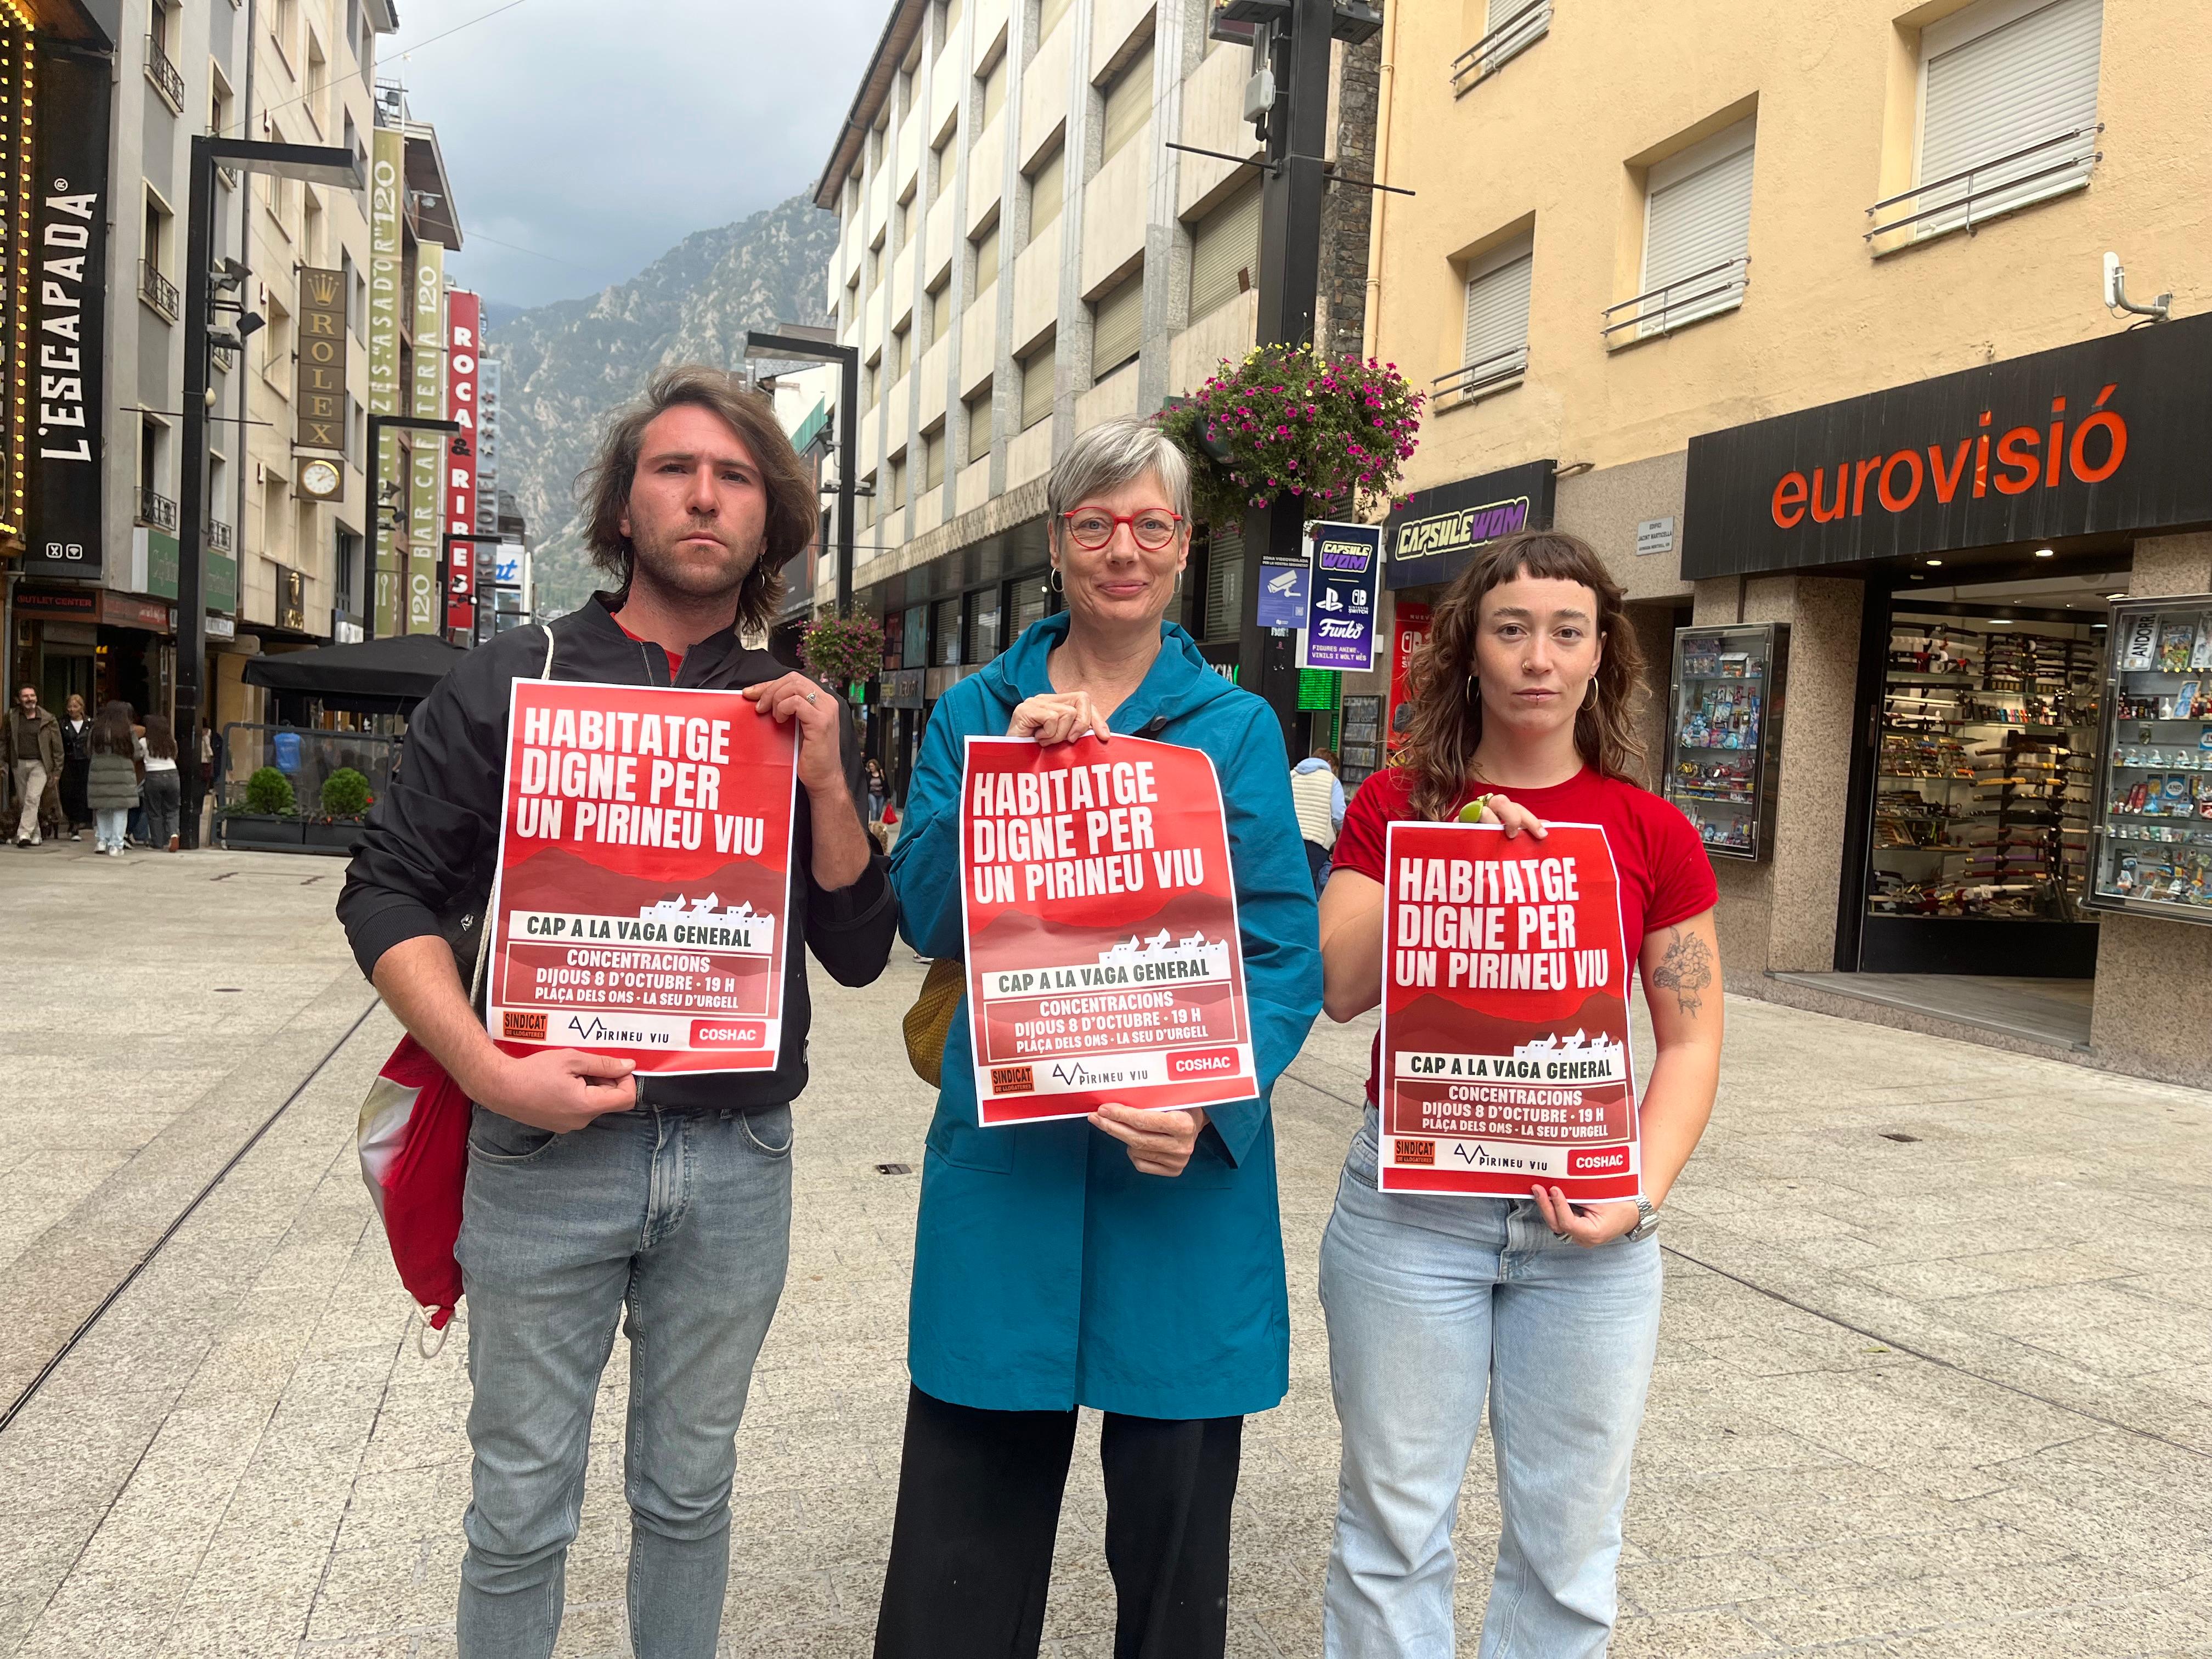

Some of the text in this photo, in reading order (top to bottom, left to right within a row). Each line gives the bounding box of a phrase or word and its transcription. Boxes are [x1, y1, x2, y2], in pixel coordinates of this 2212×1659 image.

[373, 160, 396, 224] 120
[418, 265, 437, 315] 120
[309, 312, 335, 445] ROLEX
[453, 326, 475, 429] ROCA
[415, 331, 437, 487] CAFTERIA
[1771, 382, 2129, 529] eurovisió
[1322, 553, 1368, 570] WOM
[1323, 544, 1370, 556] CAPSULE
[411, 575, 430, 624] 120
[1318, 618, 1364, 640] Funko
[2132, 613, 2157, 657] ANDORR
[1312, 644, 1338, 652] FIGURES
[524, 707, 731, 765] HABITATGE
[521, 748, 720, 810] DIGNE PER
[973, 761, 1158, 816] HABITATGE
[516, 797, 764, 856] UN PIRINEU VIU
[974, 806, 1155, 863] DIGNE PER
[974, 848, 1204, 904] UN PIRINEU VIU
[1398, 857, 1579, 904] HABITATGE
[527, 916, 752, 947] CAP A LA VAGA GENERAL
[1397, 904, 1576, 950] DIGNE PER
[567, 949, 710, 973] CONCENTRACIONS
[1395, 948, 1609, 991] UN PIRINEU VIU
[536, 968, 590, 988] DIJOUS
[595, 970, 605, 985] 8
[705, 977, 720, 992] 19
[724, 978, 735, 992] H
[999, 958, 1210, 992] CAP A LA VAGA GENERAL
[535, 988, 573, 1005] PLAÇA
[577, 990, 605, 1004] DELS
[608, 990, 634, 1004] OMS
[643, 994, 657, 1005] LA
[659, 994, 681, 1007] SEU
[1040, 991, 1173, 1017] CONCENTRACIONS
[505, 1013, 546, 1029] SINDICAT
[1014, 1019, 1065, 1039] DIJOUS
[1069, 1019, 1078, 1032] 8
[1171, 1009, 1188, 1024] 19
[1191, 1008, 1201, 1022] H
[596, 1029, 669, 1043] PIRINEU VIU
[699, 1028, 756, 1042] COSHAC
[1017, 1038, 1053, 1054] PLAÇA
[1056, 1036, 1082, 1049] DELS
[1085, 1034, 1108, 1048] OMS
[1116, 1032, 1130, 1045] LA
[1132, 1031, 1153, 1043] SEU
[992, 1068, 1030, 1084] SINDICAT
[1176, 1056, 1231, 1072] COSHAC
[1411, 1056, 1612, 1079] CAP A LA VAGA GENERAL
[1079, 1070, 1148, 1085] PIRINEU VIU
[1448, 1085, 1582, 1106] CONCENTRACIONS
[1422, 1101, 1471, 1120] DIJOUS
[1475, 1104, 1483, 1117] 8
[1578, 1109, 1592, 1122] 19
[1595, 1108, 1604, 1121] H
[1422, 1118, 1457, 1132] PLAÇA
[1459, 1120, 1486, 1132] DELS
[1489, 1122, 1513, 1135] OMS
[1521, 1124, 1534, 1136] LA
[1537, 1125, 1558, 1137] SEU
[1396, 1141, 1433, 1155] SINDICAT
[1480, 1155, 1547, 1170] PIRINEU VIU
[1576, 1155, 1623, 1168] COSHAC
